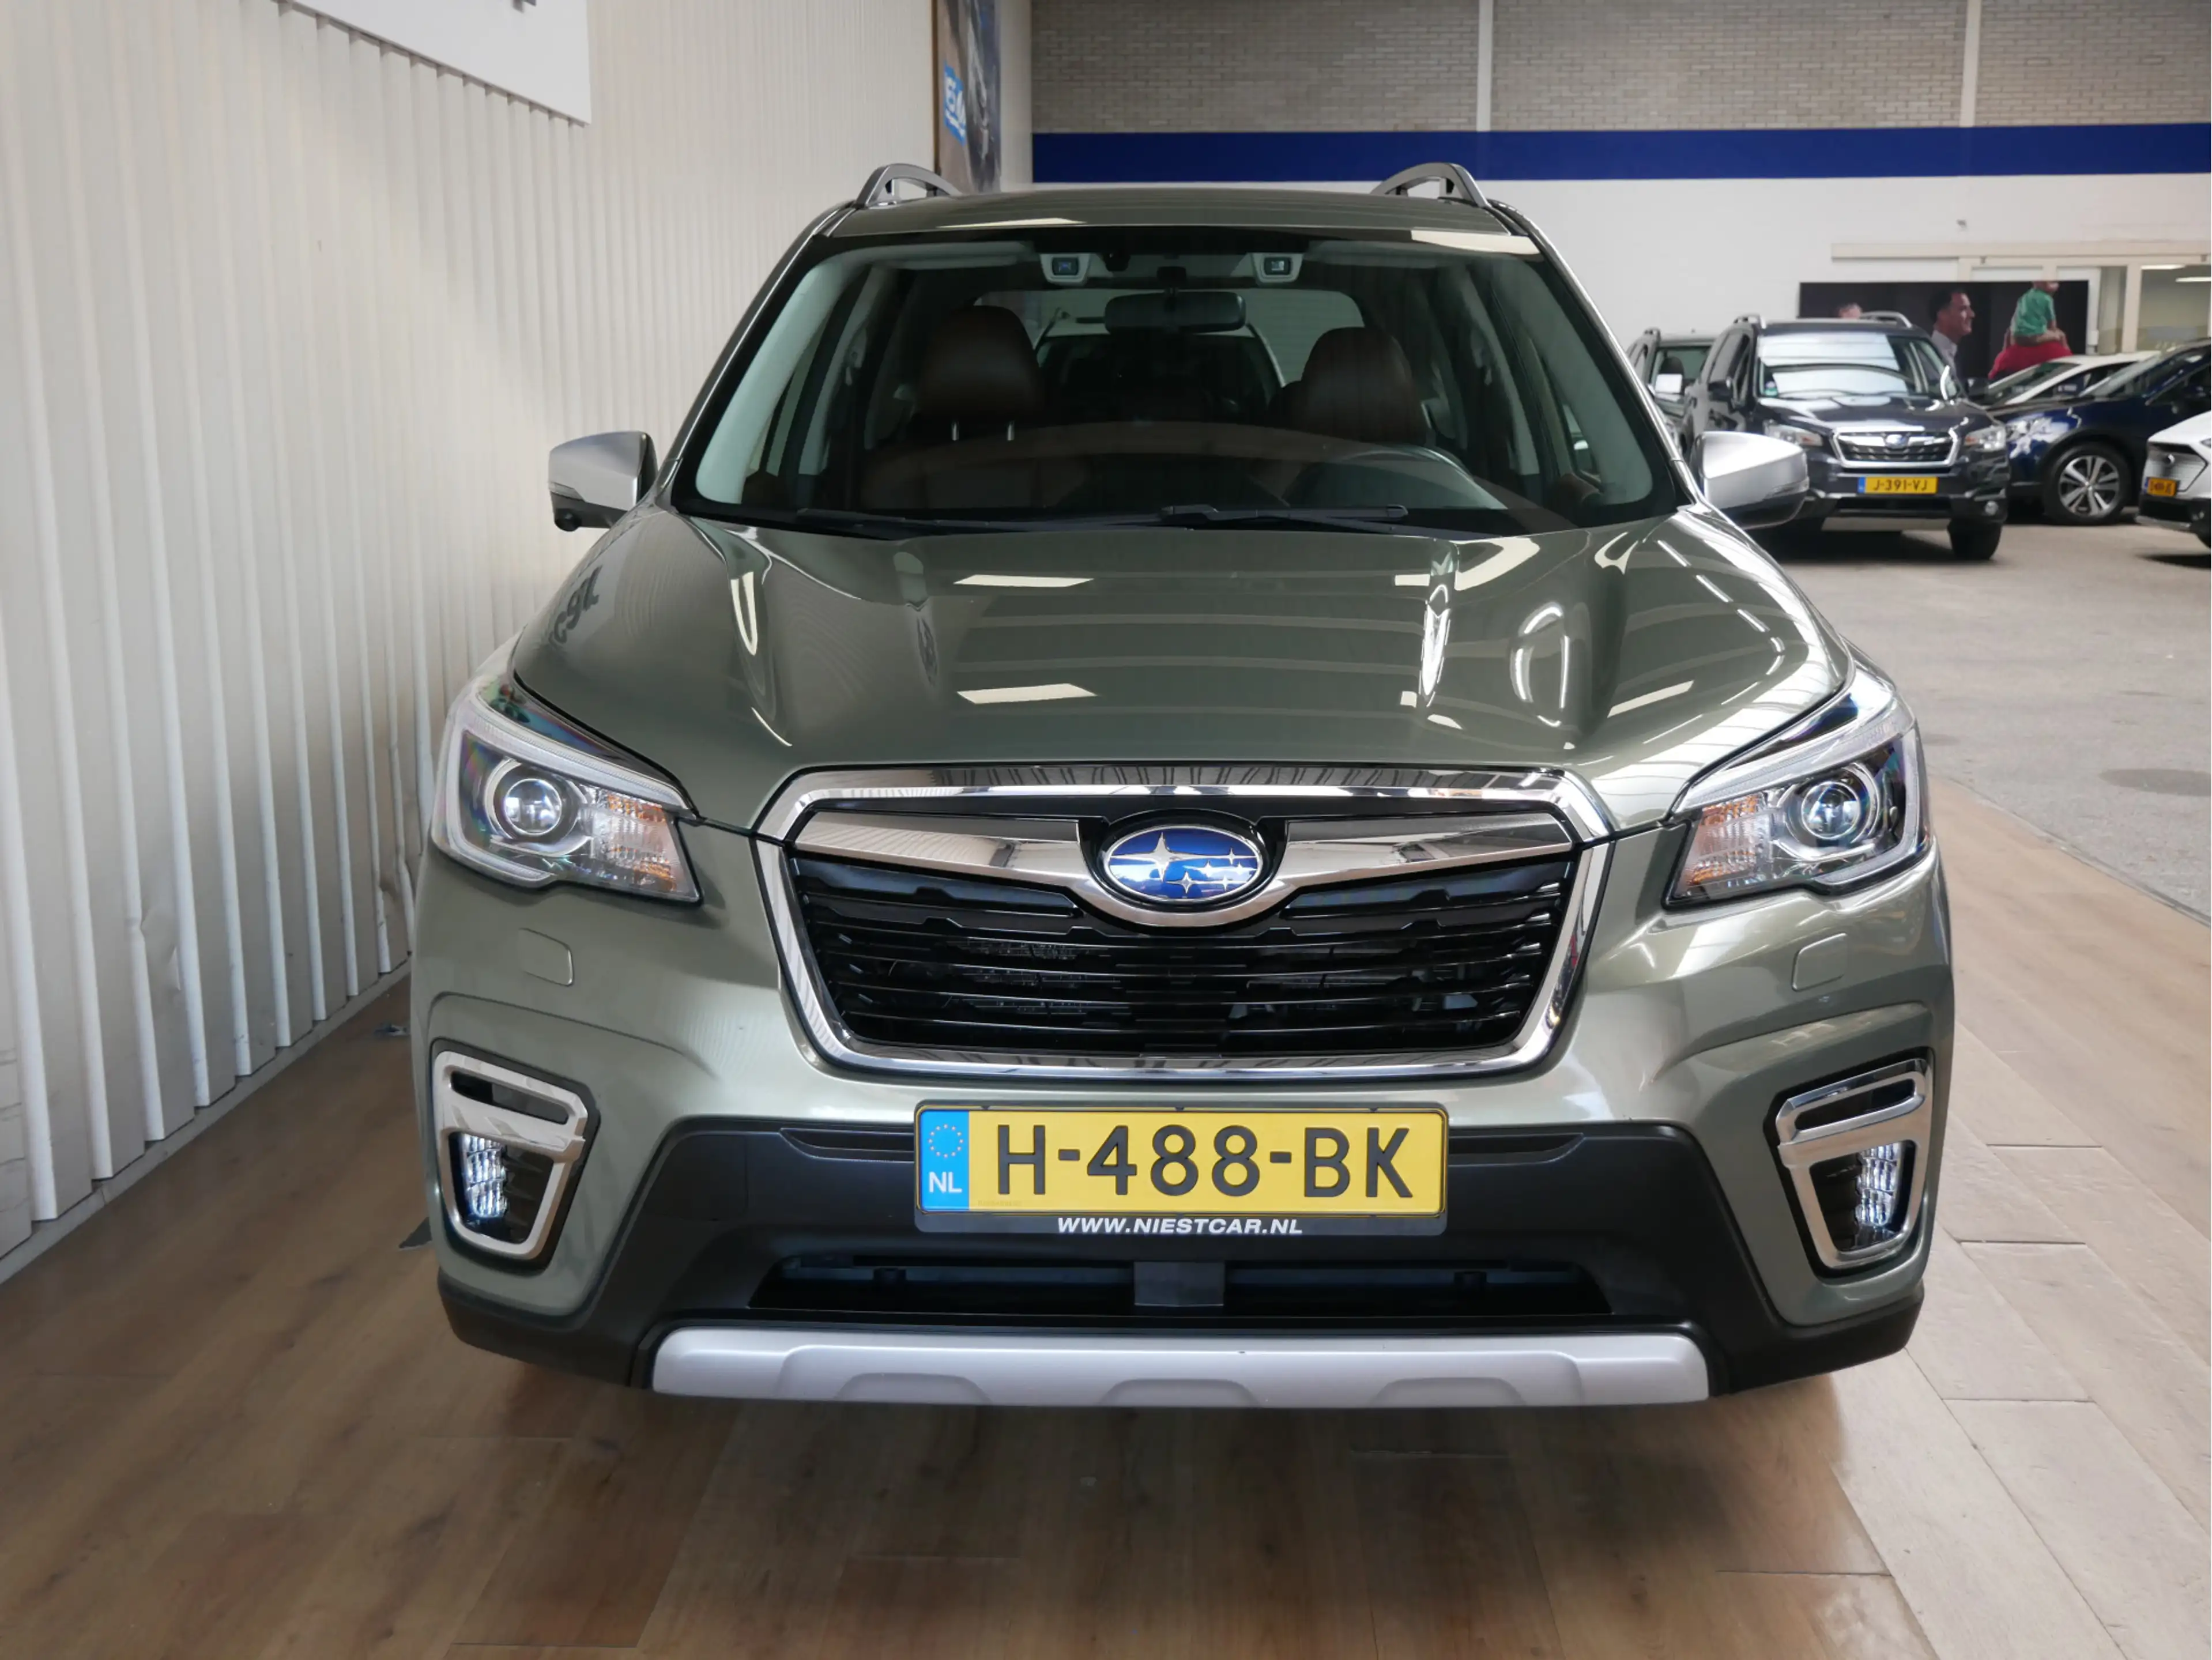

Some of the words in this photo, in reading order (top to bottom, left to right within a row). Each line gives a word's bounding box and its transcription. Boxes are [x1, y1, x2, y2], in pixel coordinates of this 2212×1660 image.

[1872, 479, 1928, 491] J-391-VJ
[928, 1171, 963, 1193] NL
[997, 1124, 1413, 1198] H-488-BK
[1057, 1217, 1303, 1235] WWW.NIESTCAR.NL
